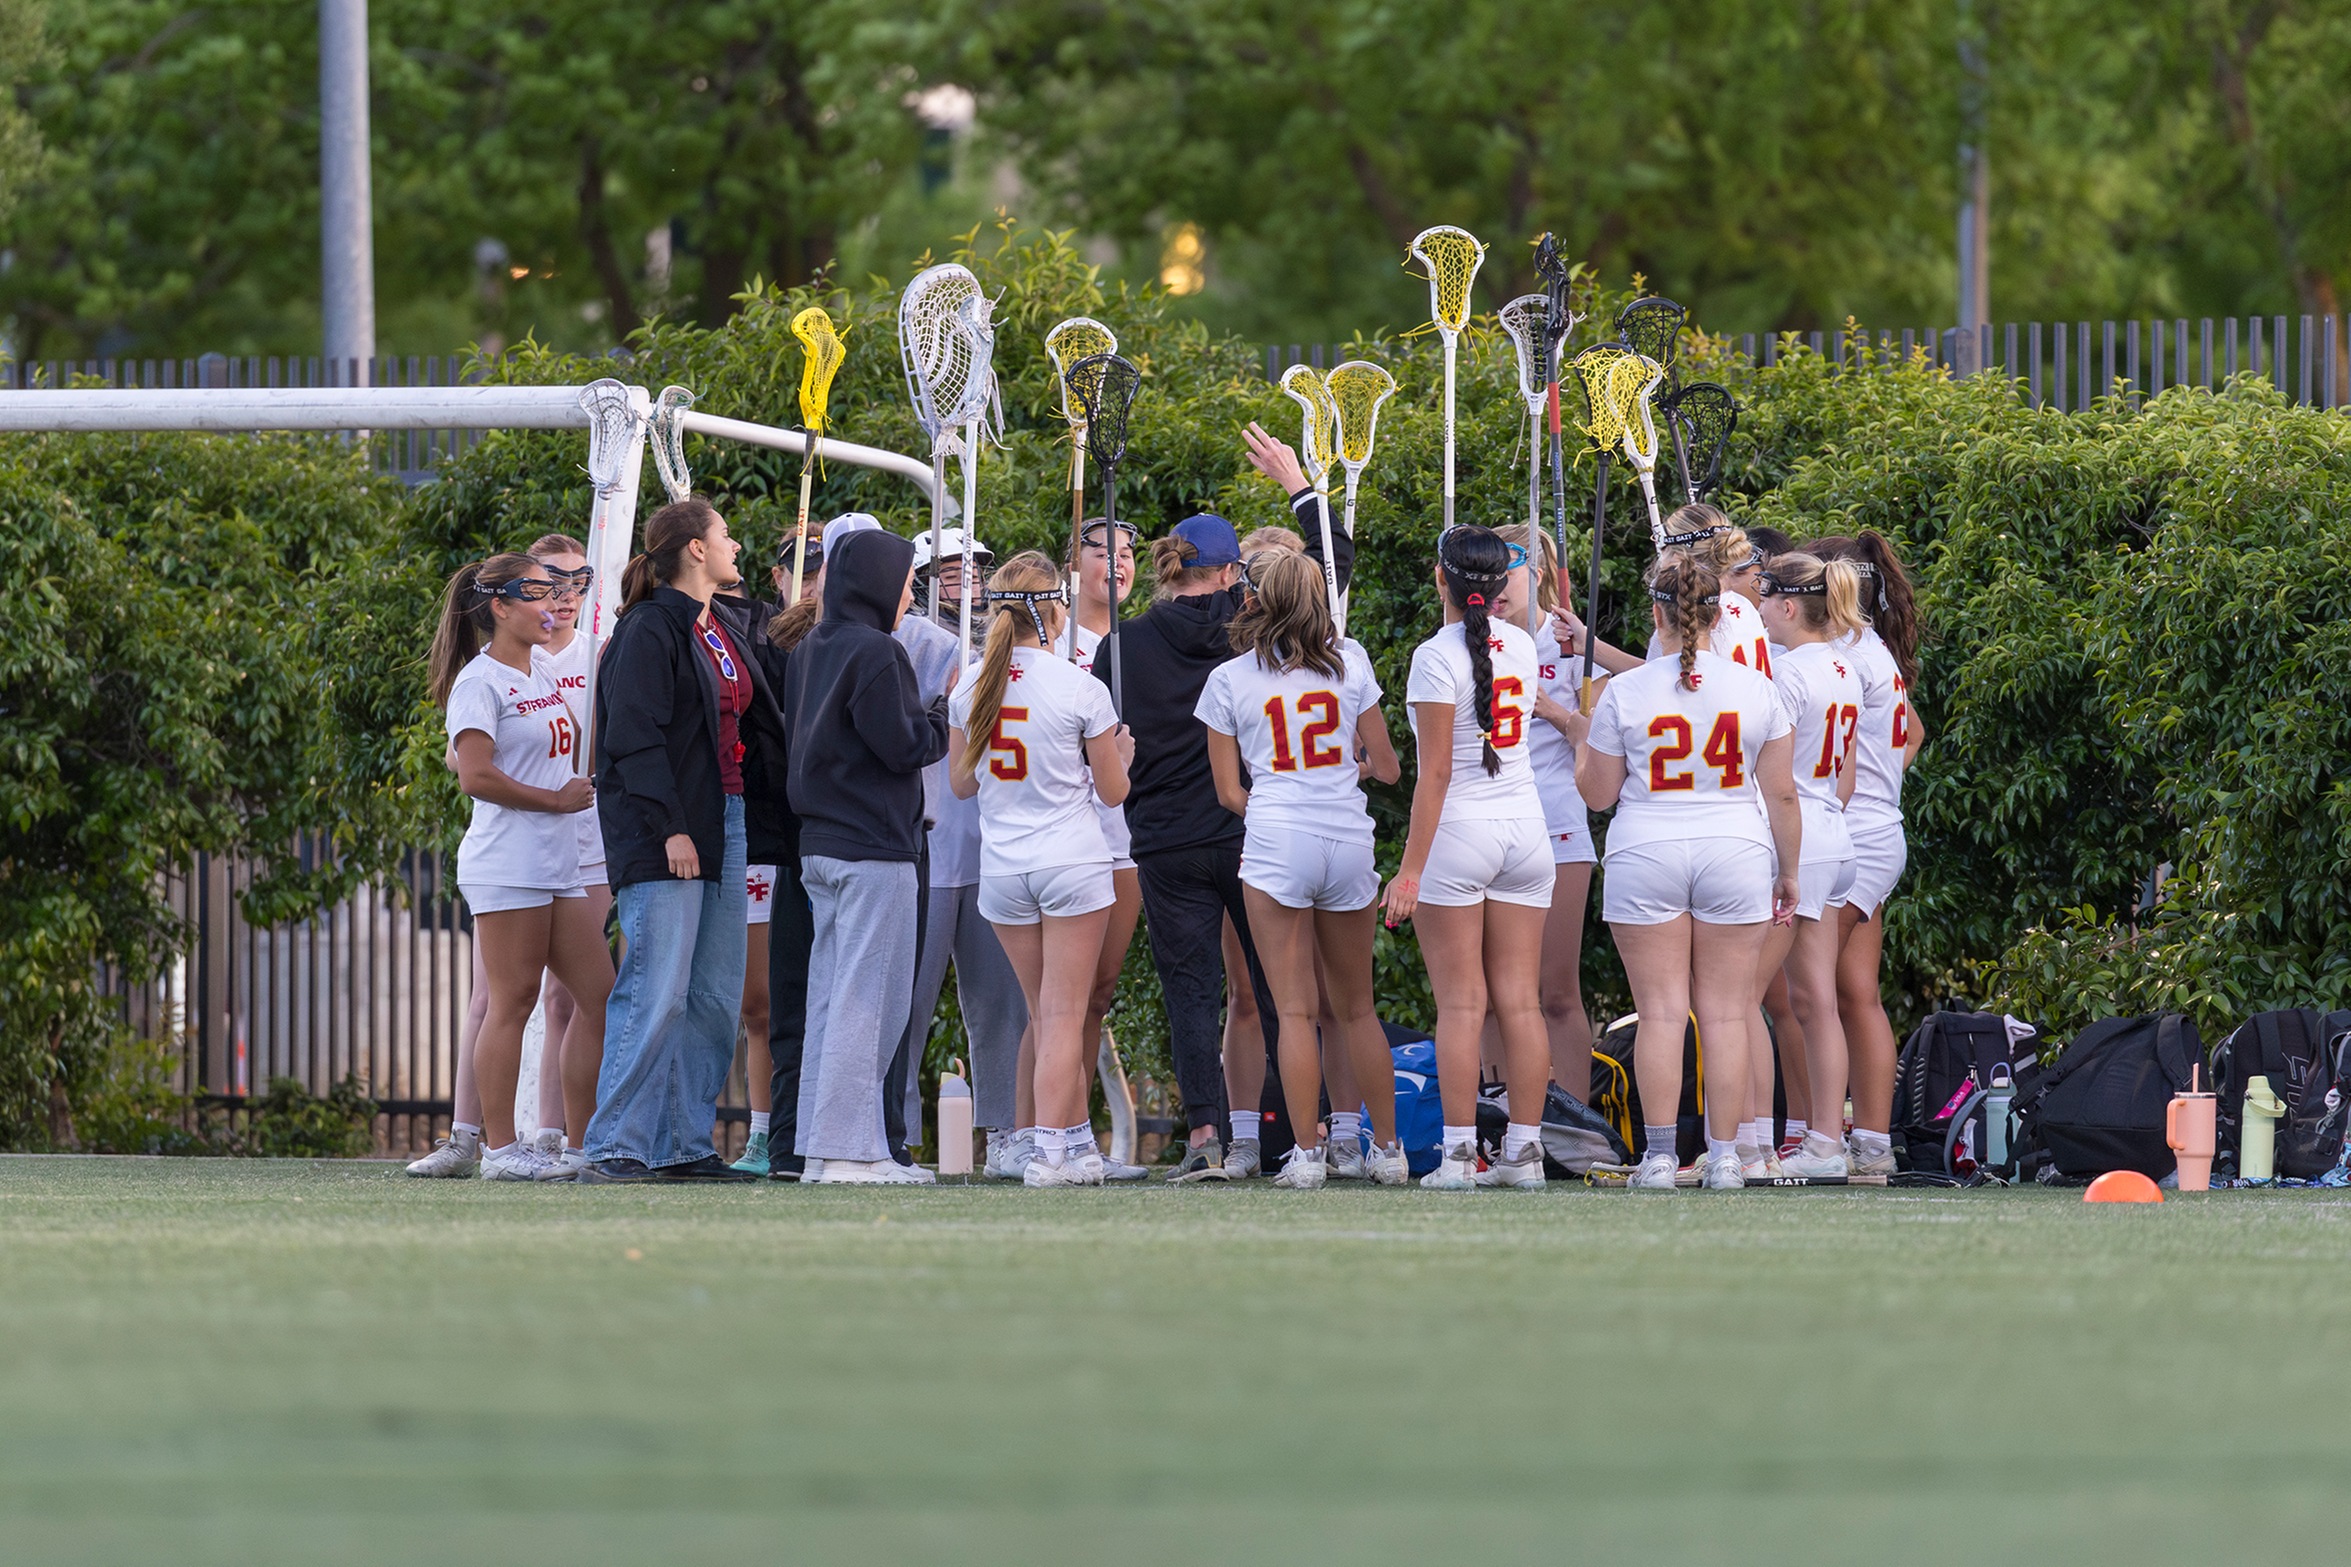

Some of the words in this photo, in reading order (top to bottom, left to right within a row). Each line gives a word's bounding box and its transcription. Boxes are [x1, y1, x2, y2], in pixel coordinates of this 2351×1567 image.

[1325, 559, 1334, 585] GAIT
[1656, 590, 1672, 601] STX
[548, 716, 572, 759] 16
[1263, 689, 1343, 774] 12
[1490, 674, 1525, 750] 6
[988, 705, 1029, 783] 5
[1647, 710, 1745, 793] 24
[1773, 1177, 1809, 1187] GAIT
